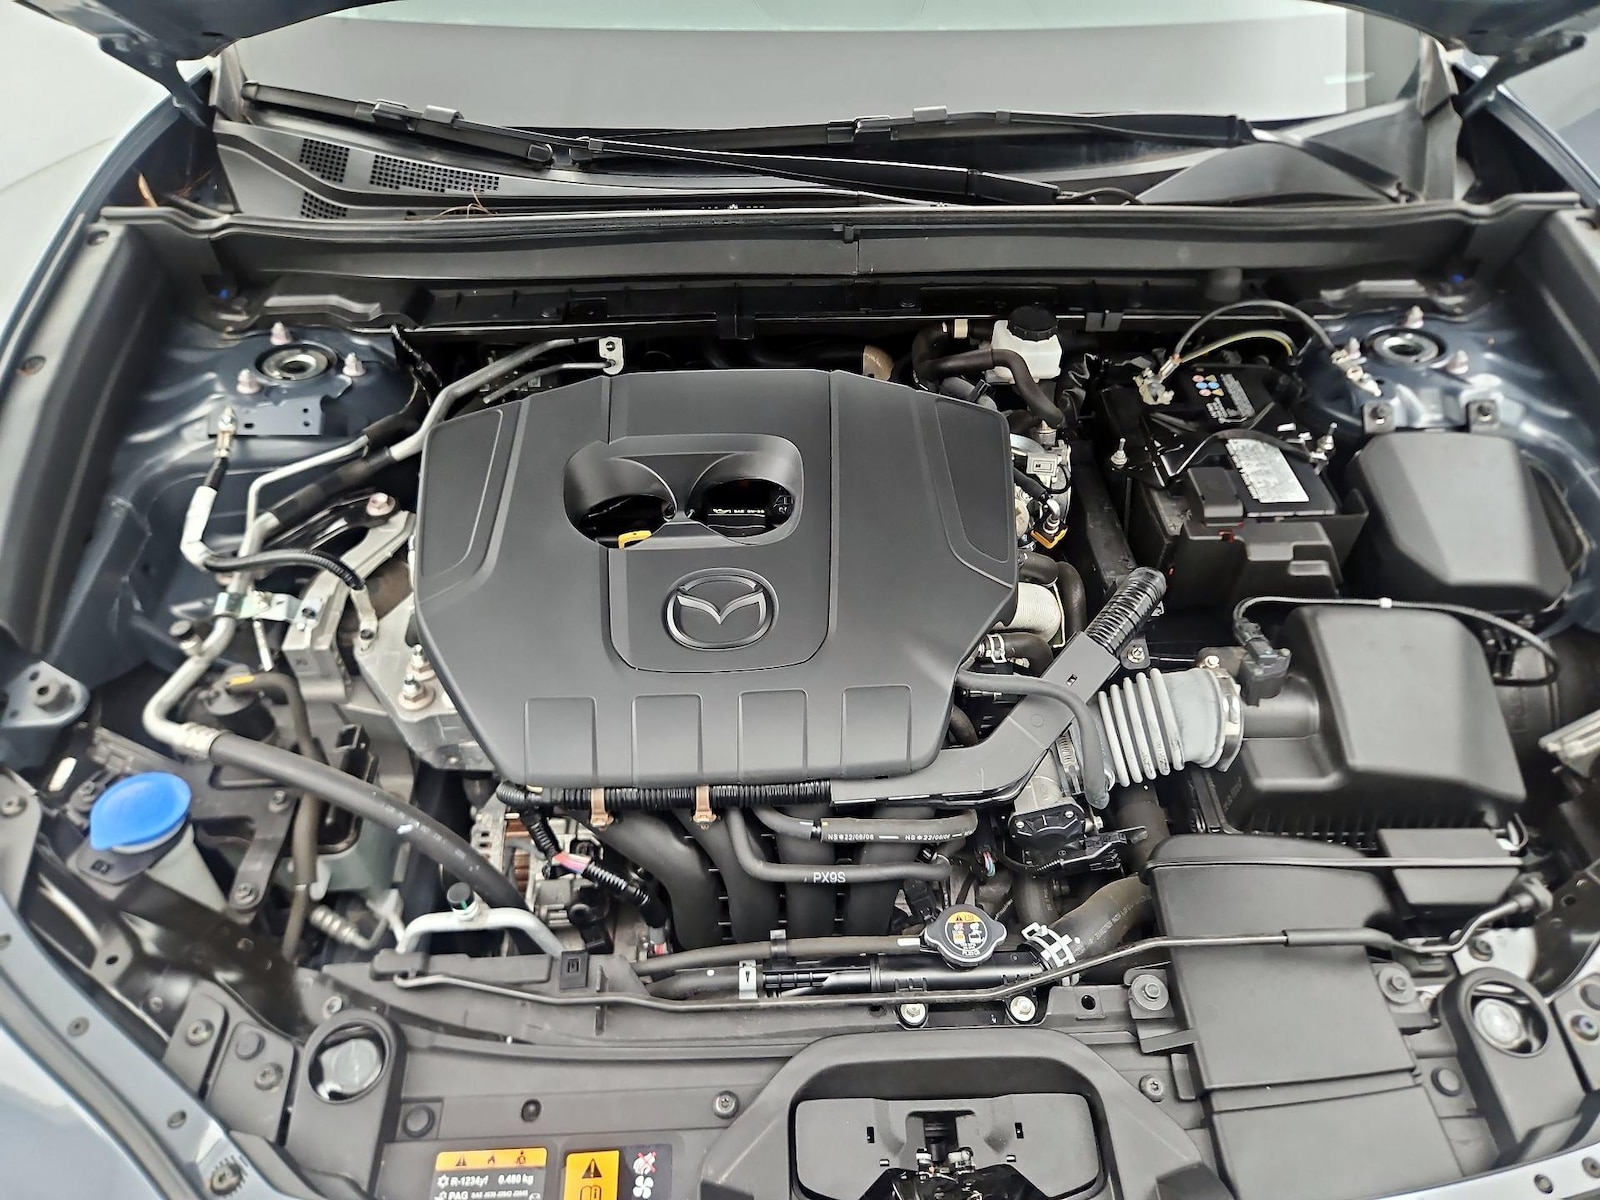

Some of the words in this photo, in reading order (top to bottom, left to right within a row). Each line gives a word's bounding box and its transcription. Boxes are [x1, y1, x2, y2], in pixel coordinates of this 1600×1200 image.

[813, 871, 846, 883] PX9S
[522, 1174, 534, 1185] kg
[448, 1191, 469, 1200] PAG
